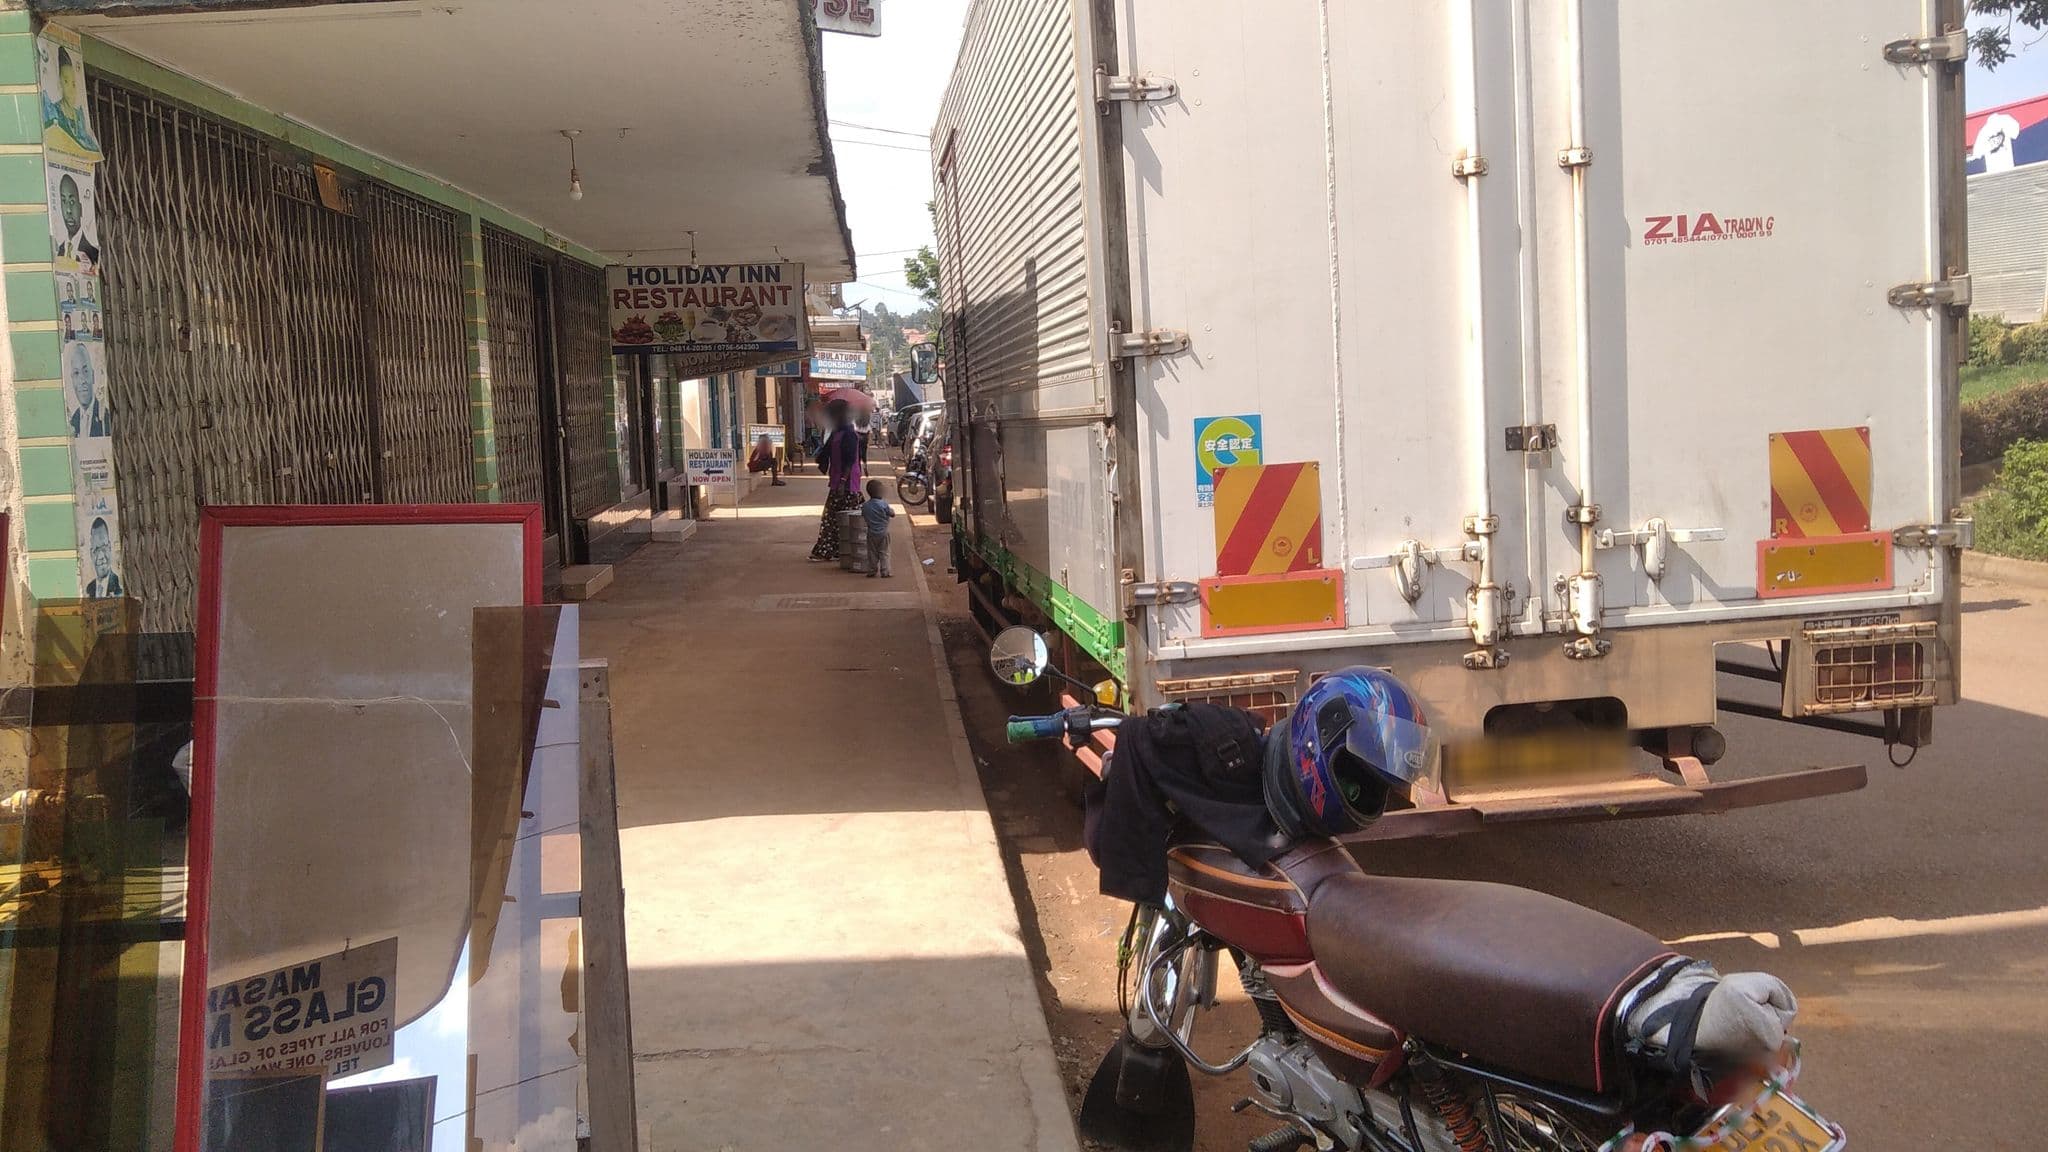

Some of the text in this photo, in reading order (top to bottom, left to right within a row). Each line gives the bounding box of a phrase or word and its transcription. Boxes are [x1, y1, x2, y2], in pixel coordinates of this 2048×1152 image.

[1644, 212, 1724, 239] ZIA
[1644, 238, 1668, 246] 0701
[627, 265, 781, 286] HOLIDAY INN
[613, 286, 793, 310] RESTAURANT
[818, 360, 857, 369] BOOKSHOP
[1205, 438, 1253, 451] 安全認定
[688, 451, 732, 459] HOLIDAY INN
[689, 460, 732, 468] RESTAURANT
[1775, 518, 1788, 534] R
[1307, 547, 1319, 564] L
